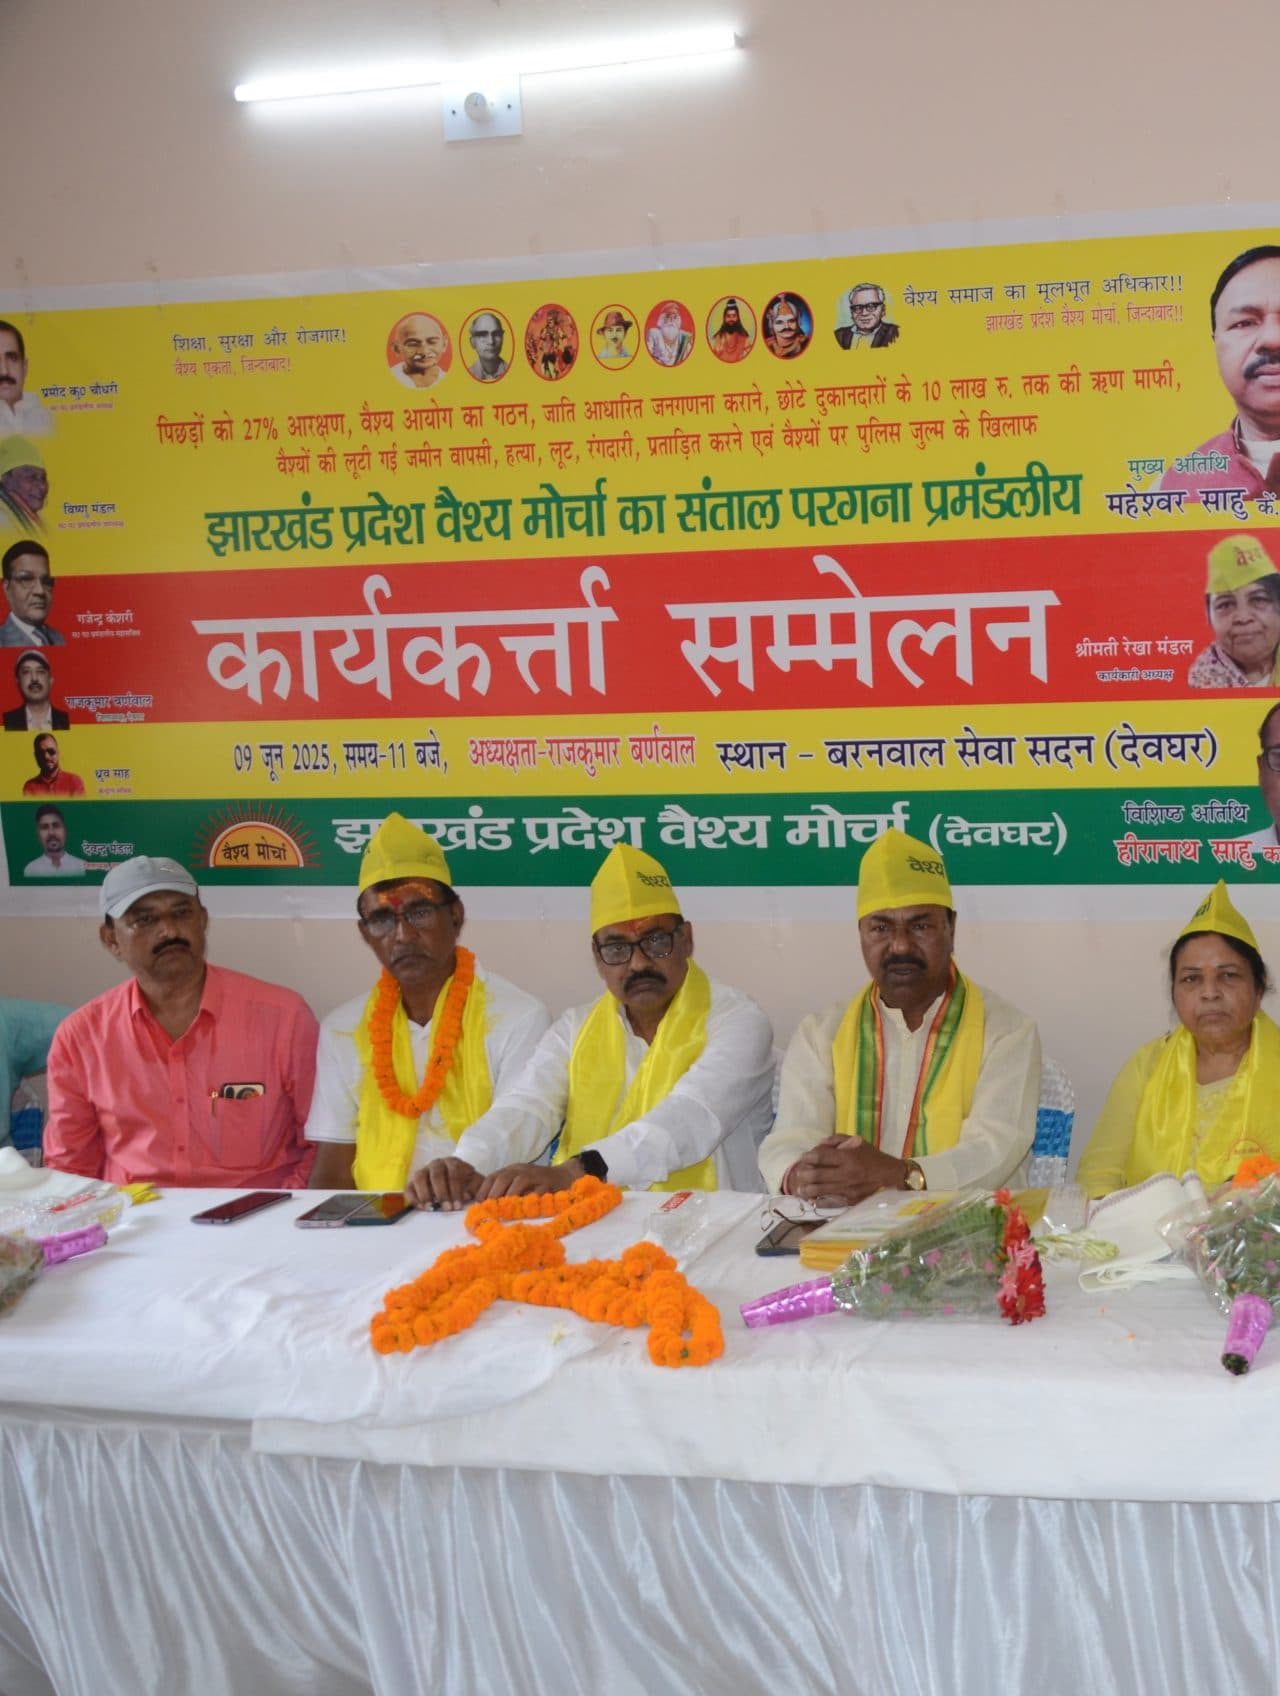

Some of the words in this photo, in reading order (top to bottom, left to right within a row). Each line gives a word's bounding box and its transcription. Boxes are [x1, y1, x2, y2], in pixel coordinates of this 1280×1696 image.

[903, 285, 937, 310] वैश्य
[948, 285, 993, 304] समाज
[1004, 284, 1026, 300] का
[1037, 280, 1090, 303] मूलभूत
[1103, 273, 1183, 294] अधिकार!!
[985, 309, 1023, 333] झारखंड
[1061, 303, 1085, 328] वैश्य
[173, 334, 211, 352] शिक्षा,
[218, 334, 254, 353] सुरक्षा
[264, 326, 288, 346] और
[296, 326, 346, 344] रोजगार!
[175, 357, 196, 377] वैश्य
[156, 412, 204, 449] पिछड़ों
[212, 410, 233, 441] को
[243, 416, 278, 441] 27%
[288, 413, 352, 441] आरक्षण,
[359, 401, 394, 435] वैश्य
[404, 398, 453, 432] आयोग
[462, 405, 484, 428] का
[493, 403, 536, 429] गठन,
[542, 396, 576, 423] जाति
[584, 392, 643, 421] आधारित
[651, 394, 715, 416] जनगणना
[723, 382, 769, 415] कराने,
[776, 379, 807, 410] छोटे
[814, 374, 886, 416] दुकानदारों
[894, 373, 912, 402] के
[922, 380, 941, 401] 10
[950, 377, 987, 399] लाख
[995, 375, 1013, 399] रु.
[1021, 374, 1050, 396] तक
[1058, 364, 1081, 394] की
[1089, 370, 1125, 394] ऋण
[1132, 359, 1181, 392] माफी,
[276, 447, 310, 477] वैश्यों
[317, 446, 336, 473] की
[343, 444, 371, 480] लूटी
[378, 442, 397, 477] गई
[405, 441, 442, 468] जमीन
[449, 438, 498, 468] वापसी,
[504, 443, 542, 467] हत्या,
[548, 441, 580, 469] लूट,
[586, 430, 640, 462] रंगदारी,
[647, 427, 701, 461] प्रताड़ित
[708, 423, 743, 453] करने
[750, 423, 774, 457] एवं
[781, 418, 820, 450] वैश्यों
[828, 425, 849, 447] पर
[856, 416, 901, 453] पुलिस
[909, 419, 944, 450] जुल्म
[952, 409, 970, 439] के
[978, 409, 1038, 438] खिलाफ
[1128, 456, 1164, 481] मुख्य
[1175, 450, 1229, 473] अतिथि
[91, 501, 116, 514] मंडल
[204, 491, 333, 557] झारखंड
[340, 491, 425, 553] प्रदेश
[434, 486, 512, 544] वैश्य
[521, 477, 607, 539] मोर्चा
[616, 494, 666, 535] का
[675, 475, 783, 533] संताल
[789, 481, 912, 527] परगना
[921, 460, 1083, 527] प्रमंडलीय
[1105, 483, 1187, 520] महेश्वर
[1198, 488, 1248, 520] साहु
[191, 566, 620, 704] कार्यकर्त्ता
[665, 554, 1061, 699] सम्मेलन
[1076, 637, 1119, 657] श्रीमती
[1122, 636, 1152, 655] रेखा
[1155, 636, 1194, 655] मंडल
[1141, 669, 1174, 682] अध्यक्ष
[234, 744, 252, 771] 09
[259, 744, 283, 782] जून
[292, 743, 337, 775] 2025,
[343, 742, 406, 770] समय-11
[414, 728, 448, 774] बजे,
[628, 723, 696, 765] बर्णवाल
[716, 741, 787, 772] स्थान
[824, 736, 946, 771] बरनवाल
[954, 727, 1016, 770] सेवा
[1024, 733, 1095, 771] सदन
[1105, 722, 1218, 771] (देवघर)
[522, 807, 645, 854] प्रदेश
[657, 804, 772, 849] वैश्य
[783, 801, 909, 848] मोर्चा
[929, 812, 1068, 855] (देवघर)
[1191, 799, 1250, 824] अतिथि
[222, 841, 250, 861] वैश्य
[255, 836, 287, 861] मोर्चा
[1115, 833, 1201, 865] हीरानाथ
[1212, 838, 1256, 870] साहु
